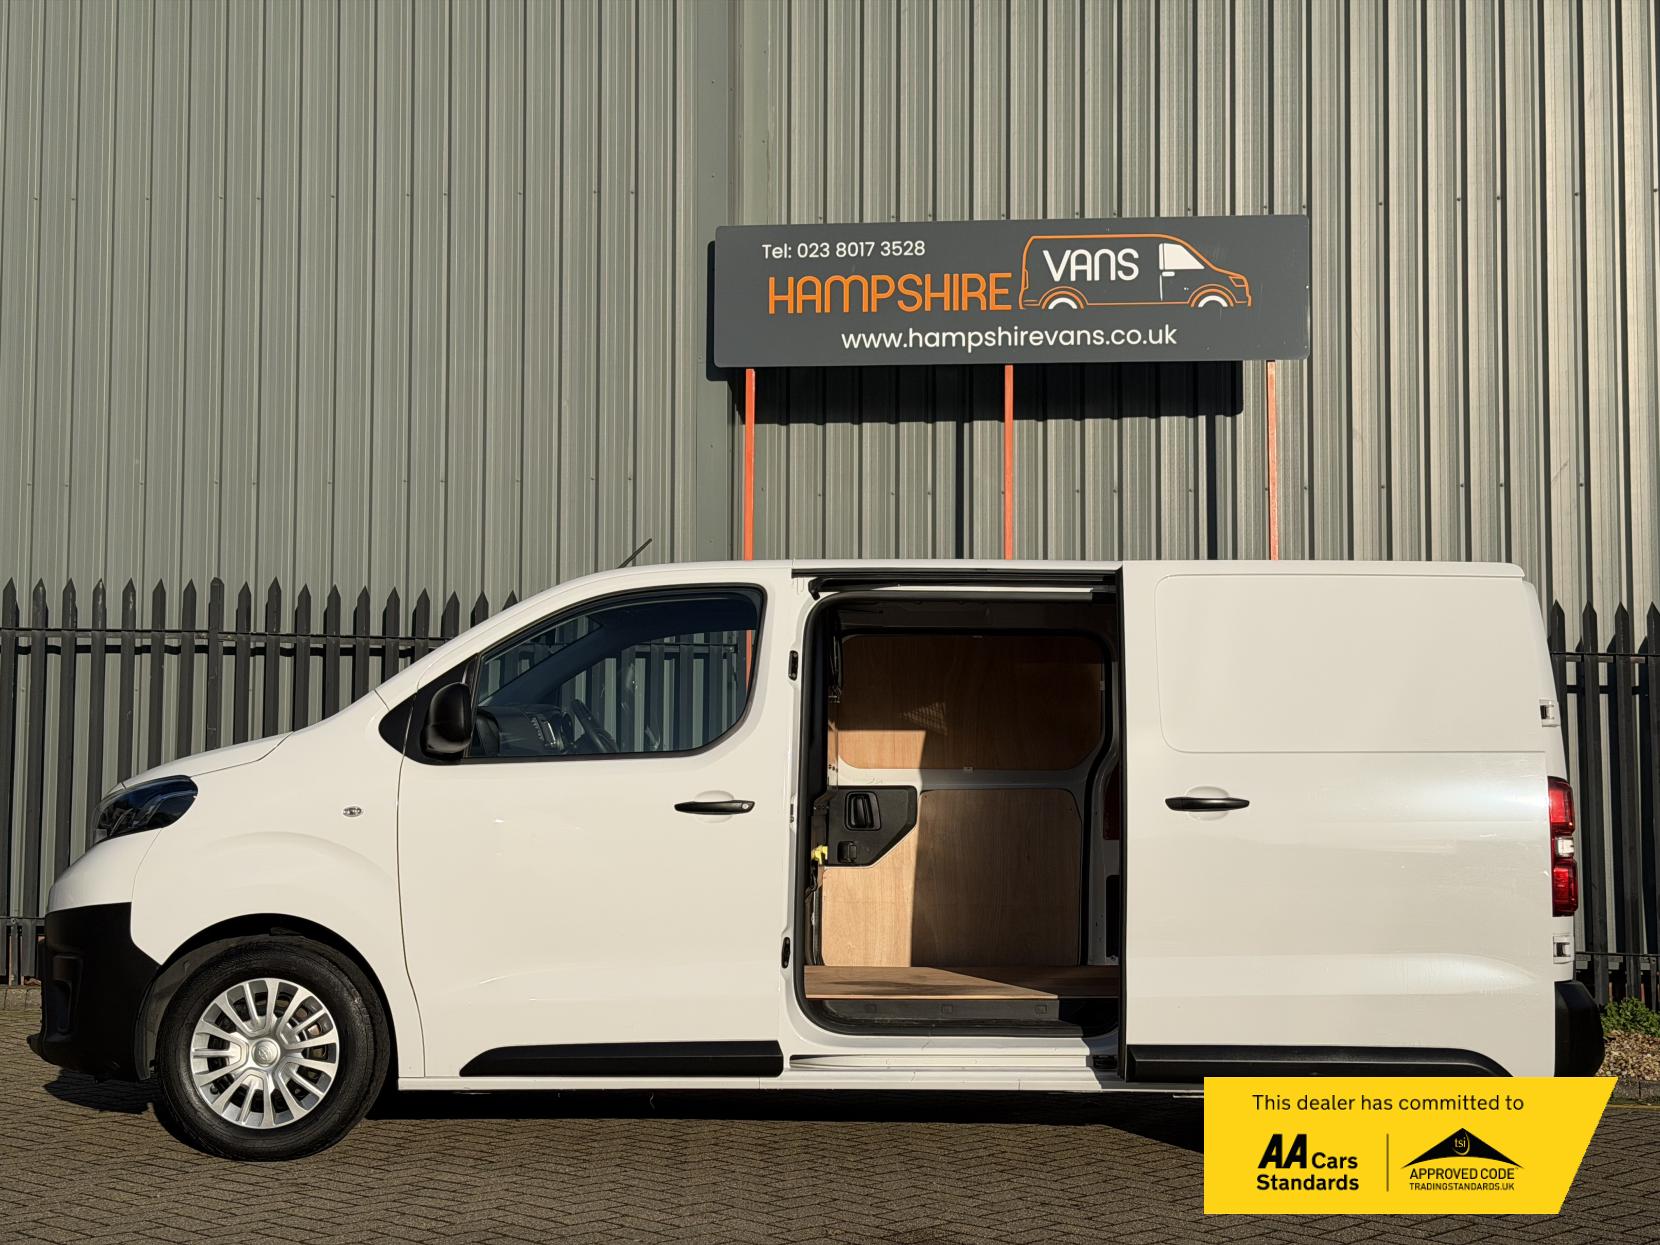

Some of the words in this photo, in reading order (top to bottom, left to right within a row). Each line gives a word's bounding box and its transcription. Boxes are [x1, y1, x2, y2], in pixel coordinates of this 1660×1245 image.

[761, 242, 792, 260] Tel:
[797, 242, 831, 259] 023
[835, 241, 876, 258] 8017
[880, 239, 926, 257] 3528
[1042, 247, 1140, 283] VANS
[768, 271, 1013, 315] HAMPSHIRE
[840, 323, 1178, 354] www.hampshirevans.co.uk
